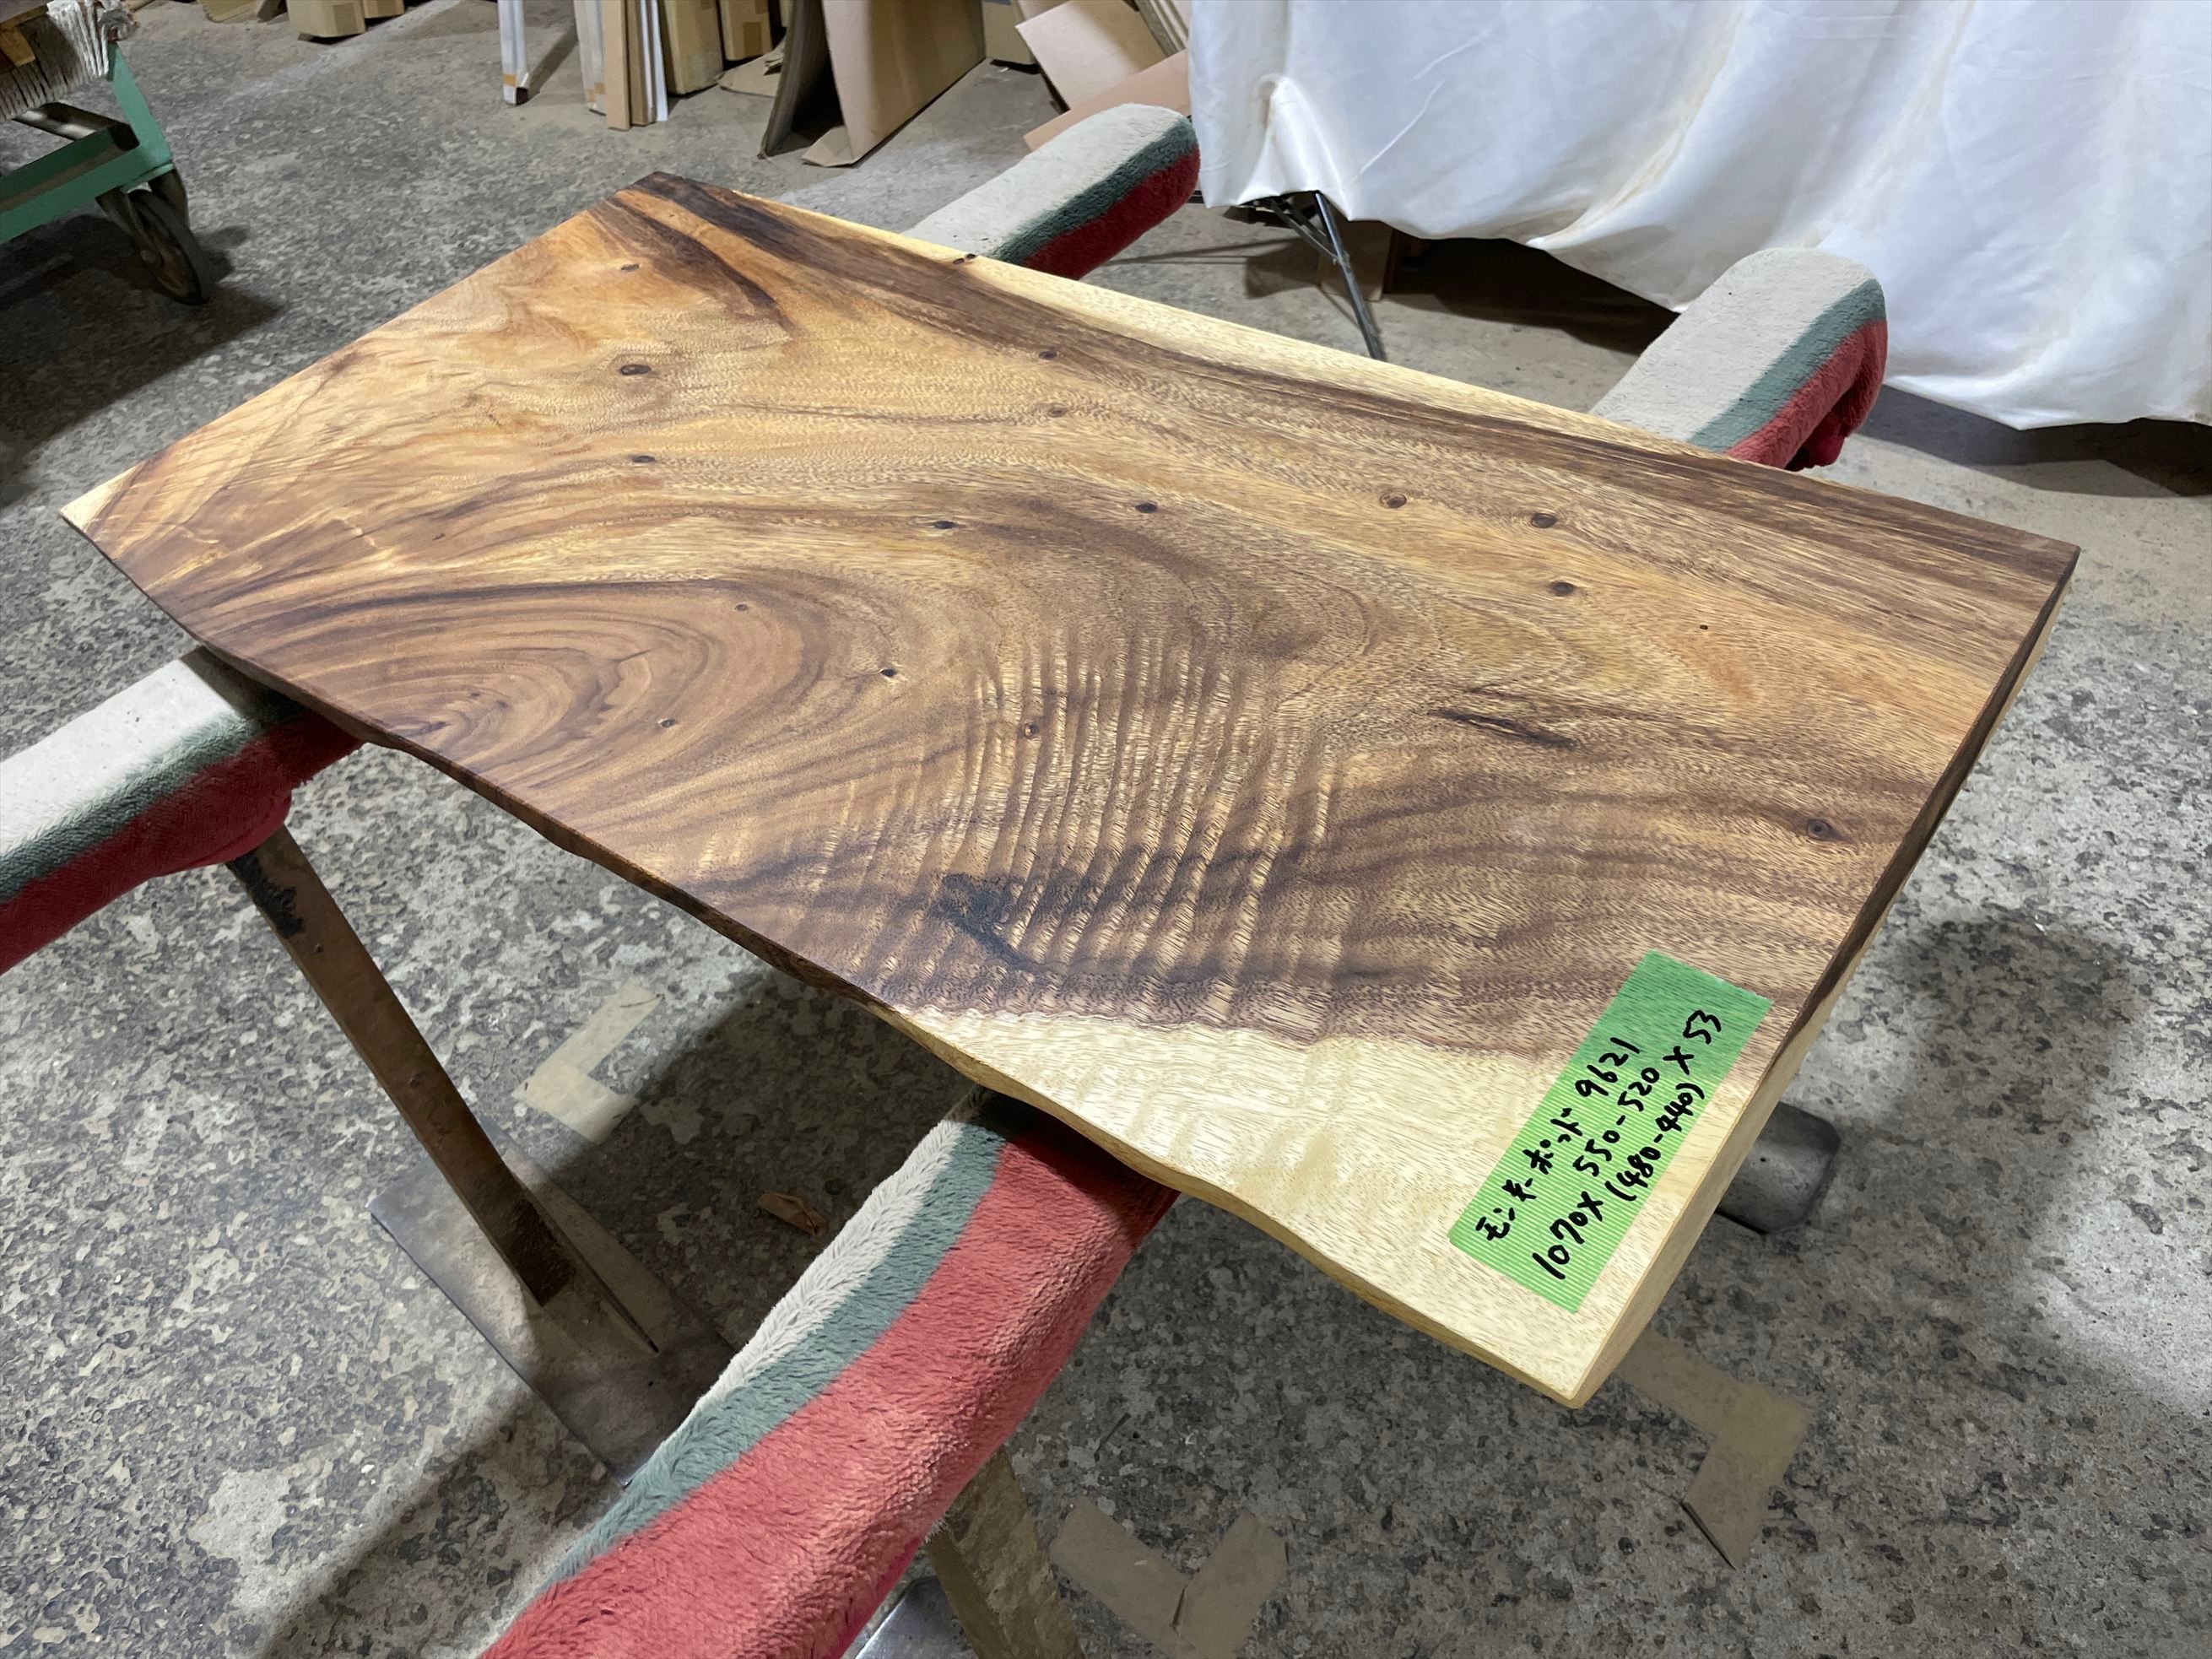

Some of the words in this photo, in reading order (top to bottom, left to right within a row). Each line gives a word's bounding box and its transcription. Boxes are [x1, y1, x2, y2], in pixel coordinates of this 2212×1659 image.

[1682, 1009, 1722, 1045] 53
[1575, 1037, 1641, 1097] 9621
[1572, 1067, 1660, 1177] 550-520
